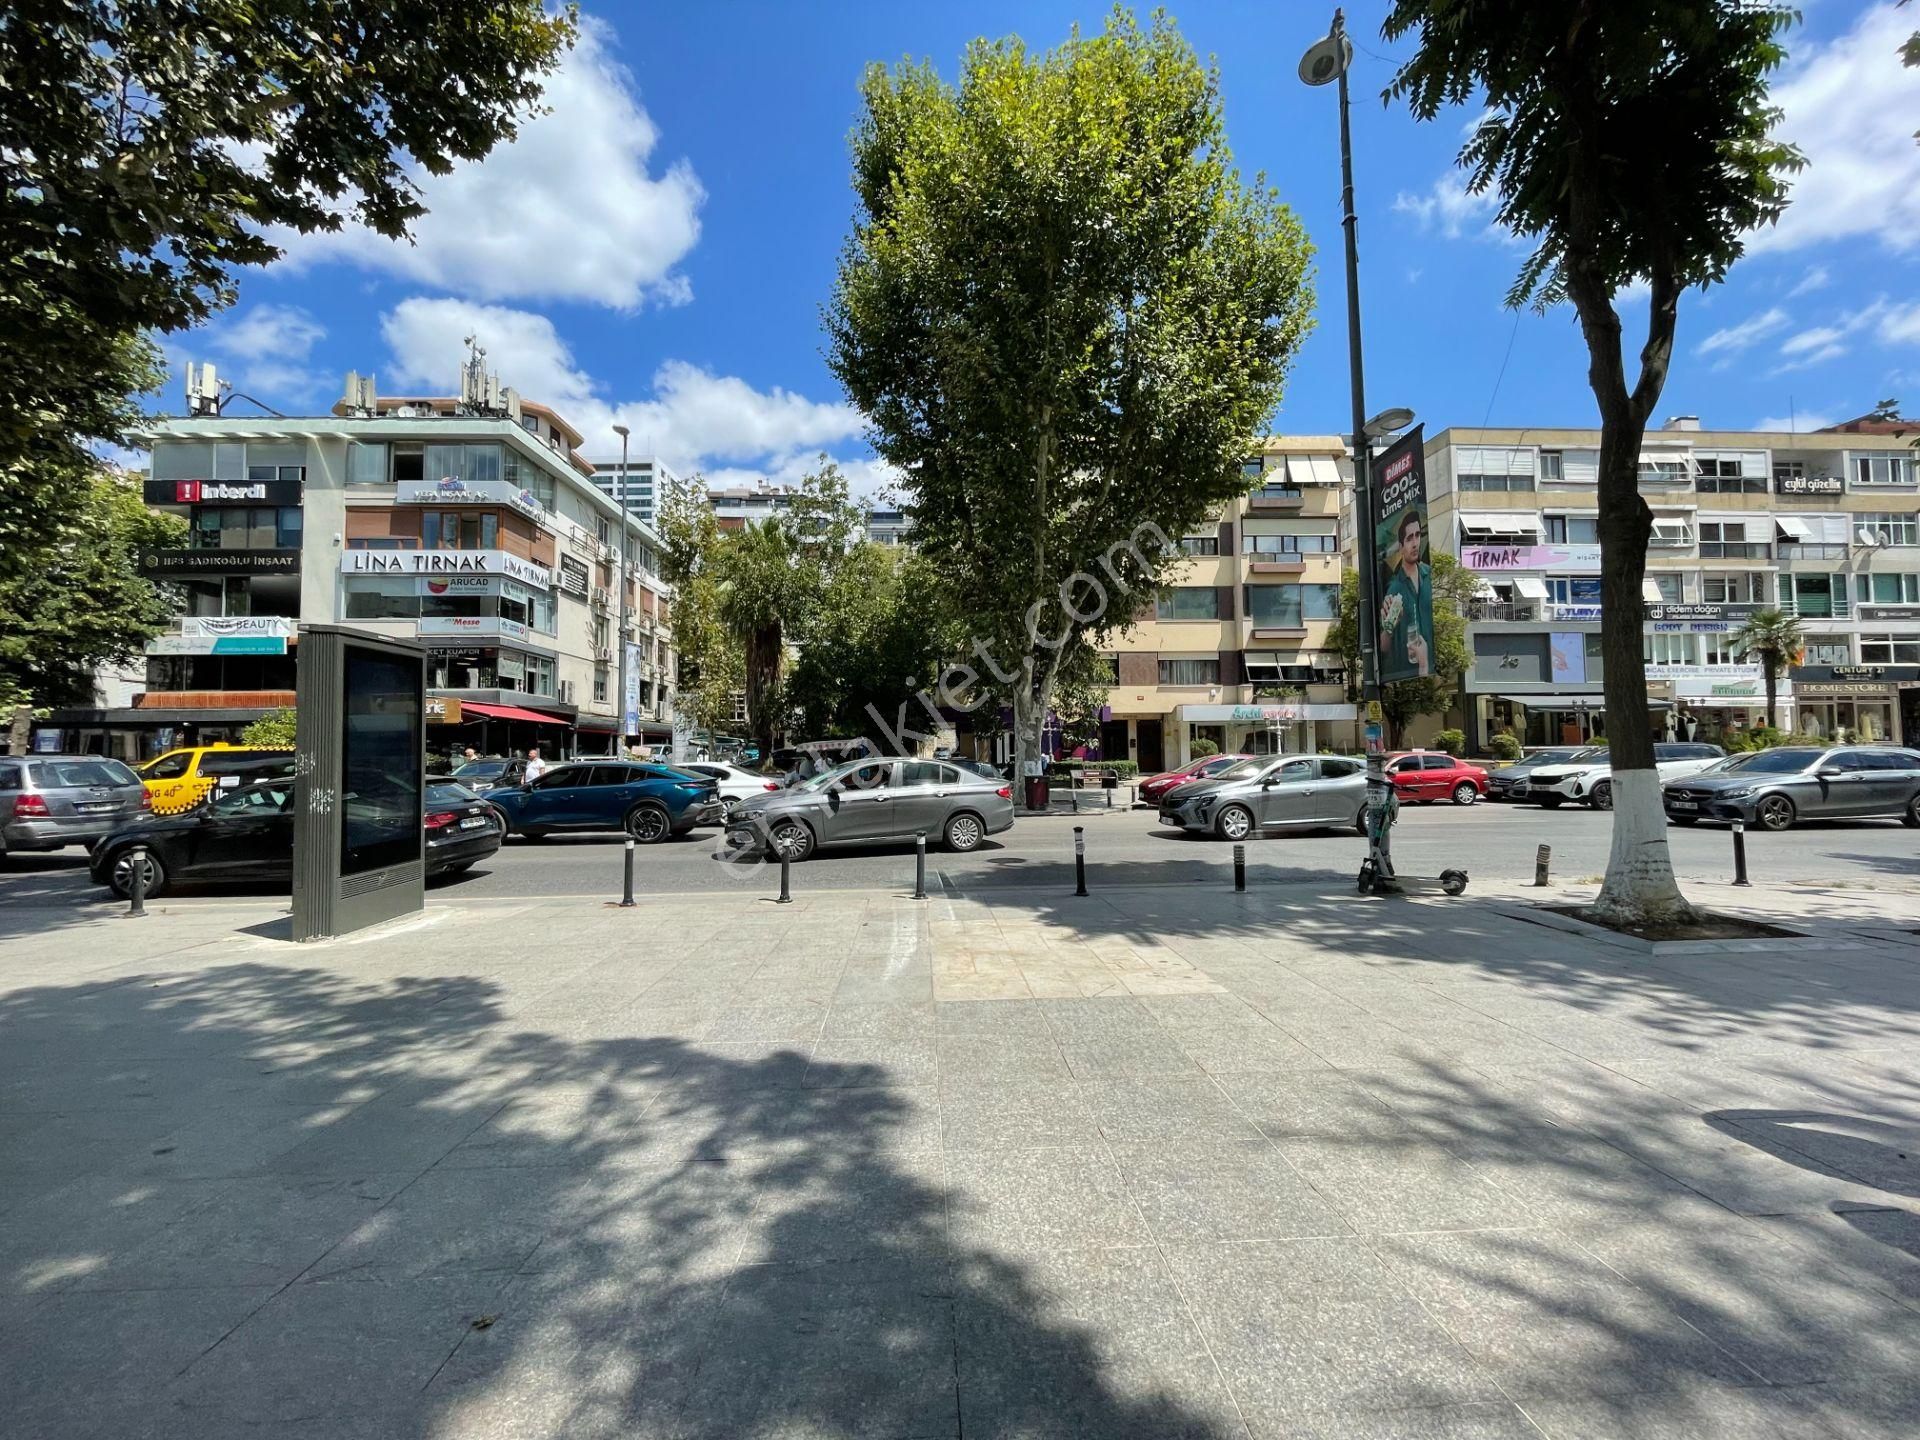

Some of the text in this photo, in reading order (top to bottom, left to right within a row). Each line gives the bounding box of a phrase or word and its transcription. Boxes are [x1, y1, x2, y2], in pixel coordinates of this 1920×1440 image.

[1383, 472, 1417, 503] COOL
[1382, 498, 1403, 519] Lime
[254, 555, 293, 566] İNŞAAT
[355, 551, 488, 570] LİNA TIRNAK
[1471, 549, 1521, 567] TIRNAK
[450, 578, 489, 586] ARUCAD
[1666, 605, 1692, 613] didem
[1694, 605, 1721, 615] doğan
[236, 619, 280, 629] BEAUTY
[1833, 666, 1873, 674] CENTURY
[1803, 684, 1886, 692] HOME STORE
